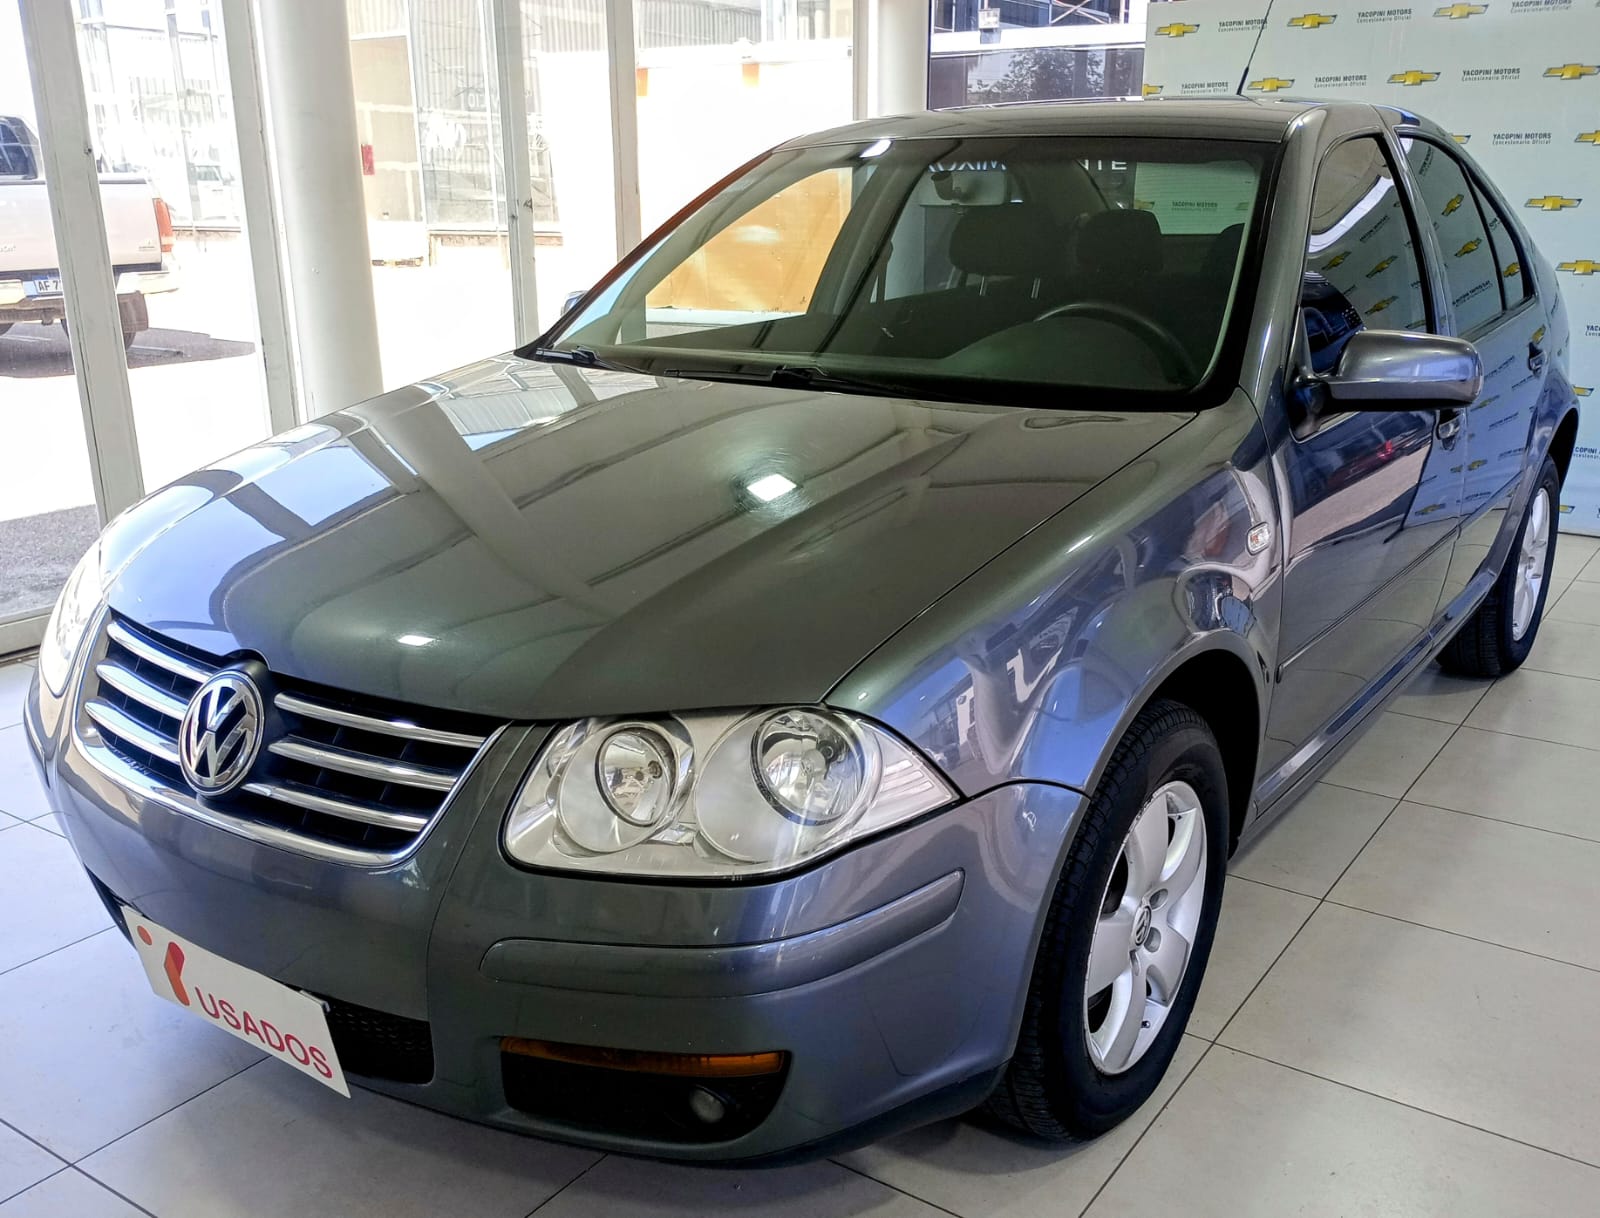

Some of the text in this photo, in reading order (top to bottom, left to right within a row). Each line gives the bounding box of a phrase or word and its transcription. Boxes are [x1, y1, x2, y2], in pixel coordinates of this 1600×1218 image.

[1512, 0, 1542, 8] YACOPINI
[1358, 8, 1412, 18] YACOPINI MOTORS
[1494, 67, 1520, 75] MOTORS
[1342, 74, 1367, 82] MOTORS
[1524, 132, 1552, 140] MOTORS
[195, 985, 333, 1079] USADOS
